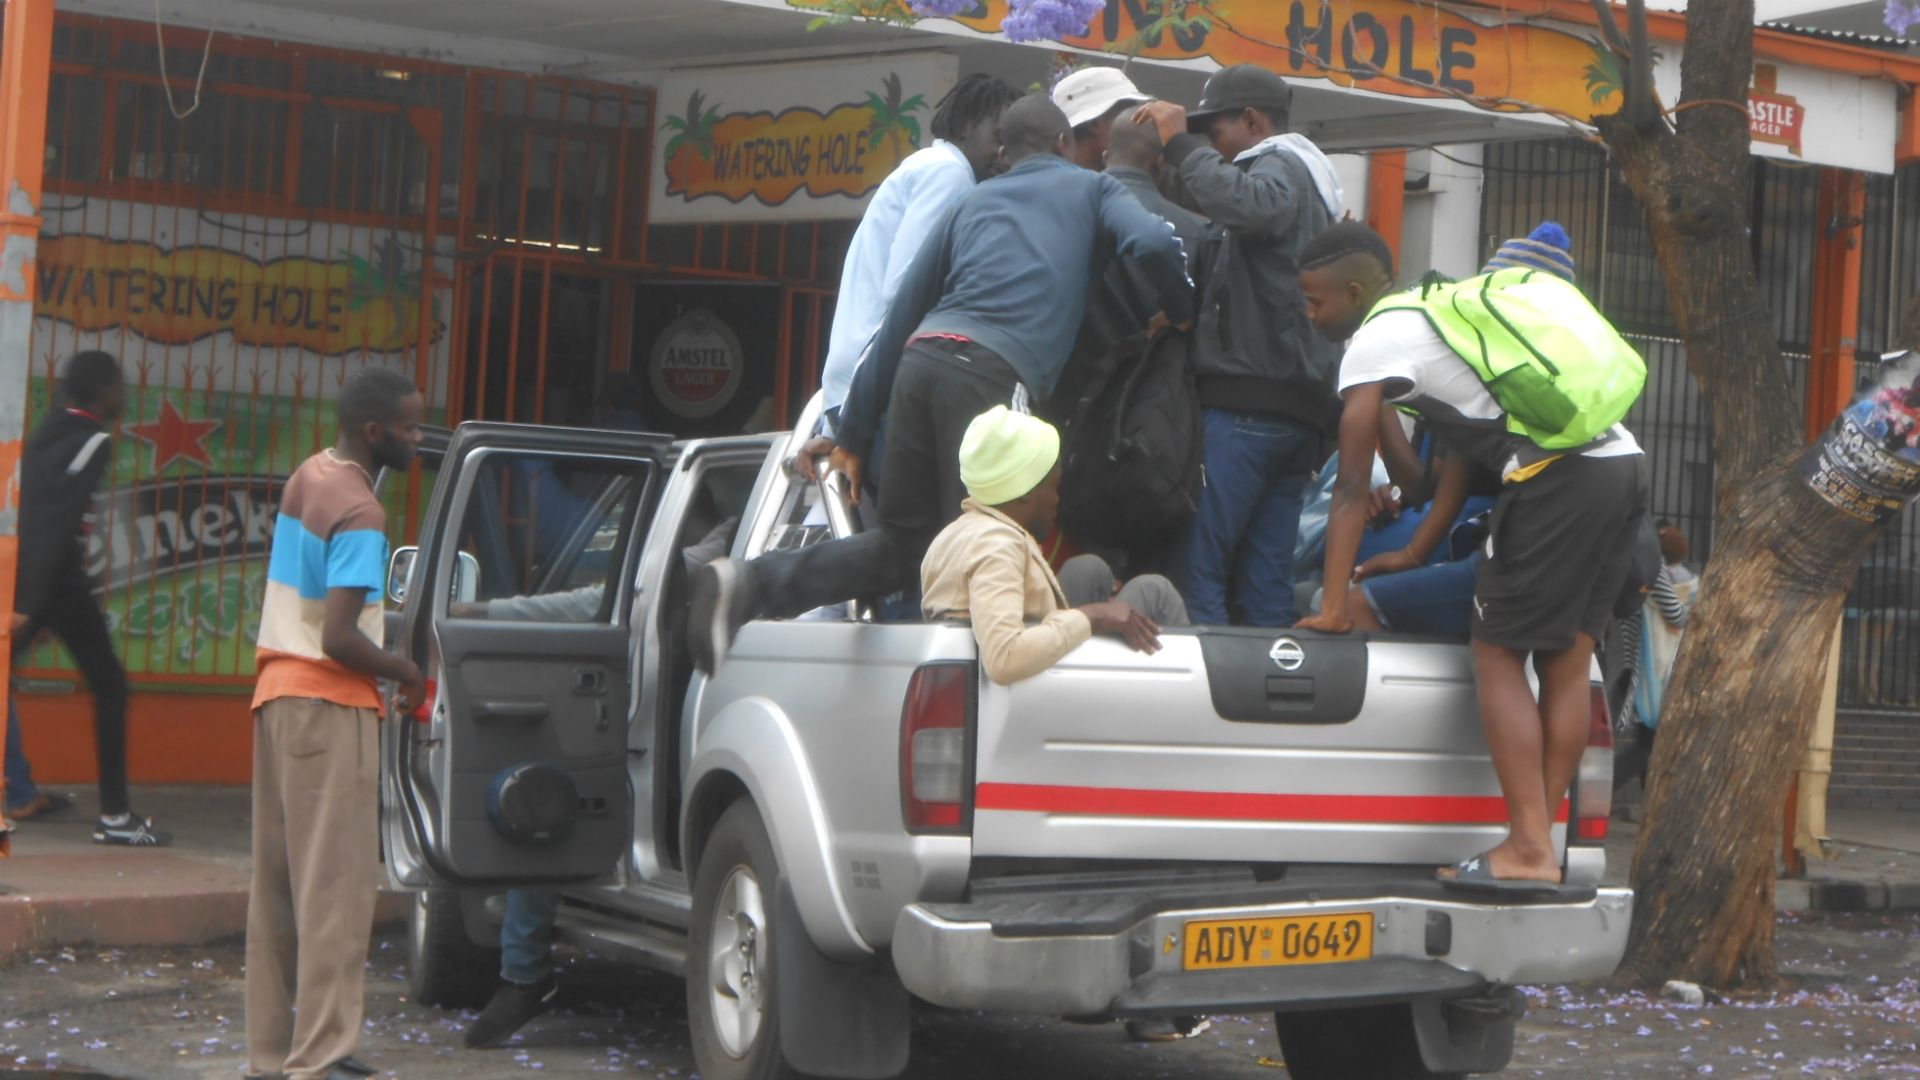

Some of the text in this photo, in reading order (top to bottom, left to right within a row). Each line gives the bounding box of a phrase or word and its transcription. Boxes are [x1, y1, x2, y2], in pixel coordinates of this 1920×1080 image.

[1287, 0, 1476, 94] HOLE
[1748, 99, 1793, 127] ASTLE
[1751, 121, 1781, 136] AGER
[714, 130, 869, 182] WATERING HOLE
[36, 262, 344, 333] WATERING HOLE
[664, 346, 729, 366] AMSTEL
[1194, 920, 1362, 963] ADY 0649
